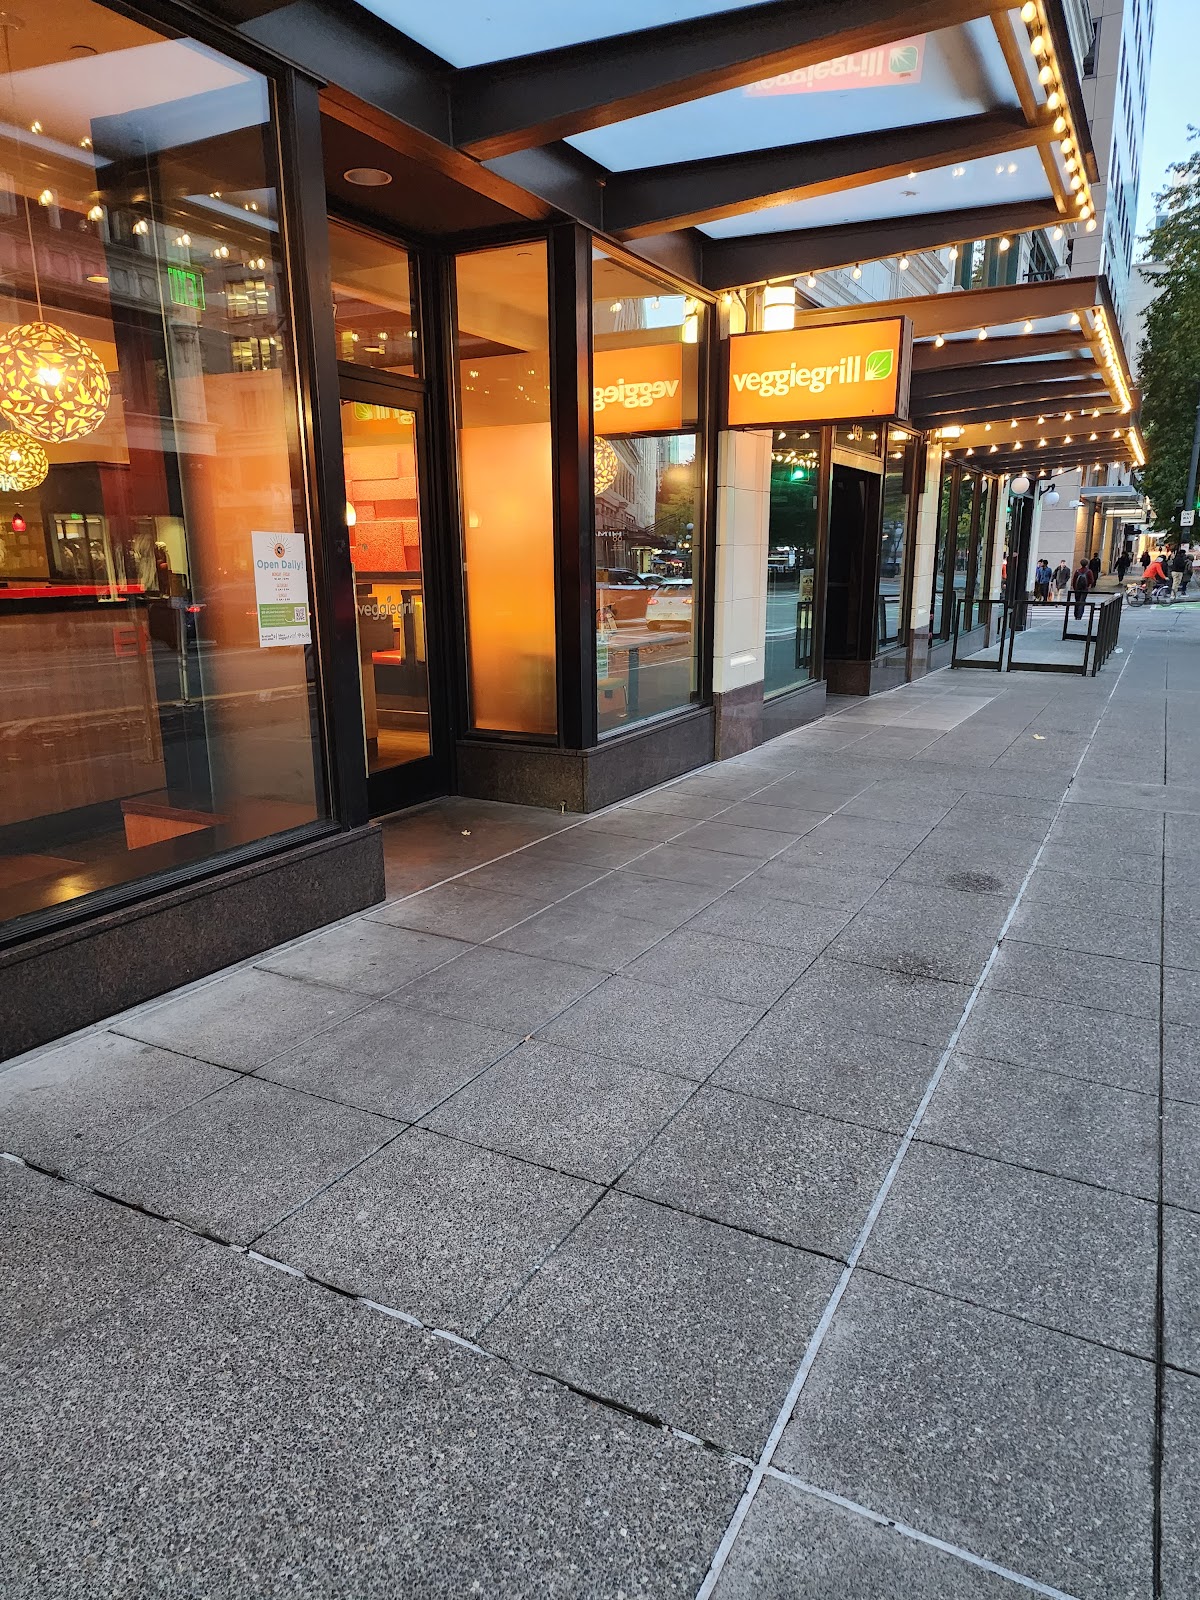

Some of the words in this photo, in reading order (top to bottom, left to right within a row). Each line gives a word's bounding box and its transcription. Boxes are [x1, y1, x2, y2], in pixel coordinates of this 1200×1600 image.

[732, 355, 861, 397] veggiegrill
[257, 559, 279, 570] Open
[281, 560, 304, 570] Daily!
